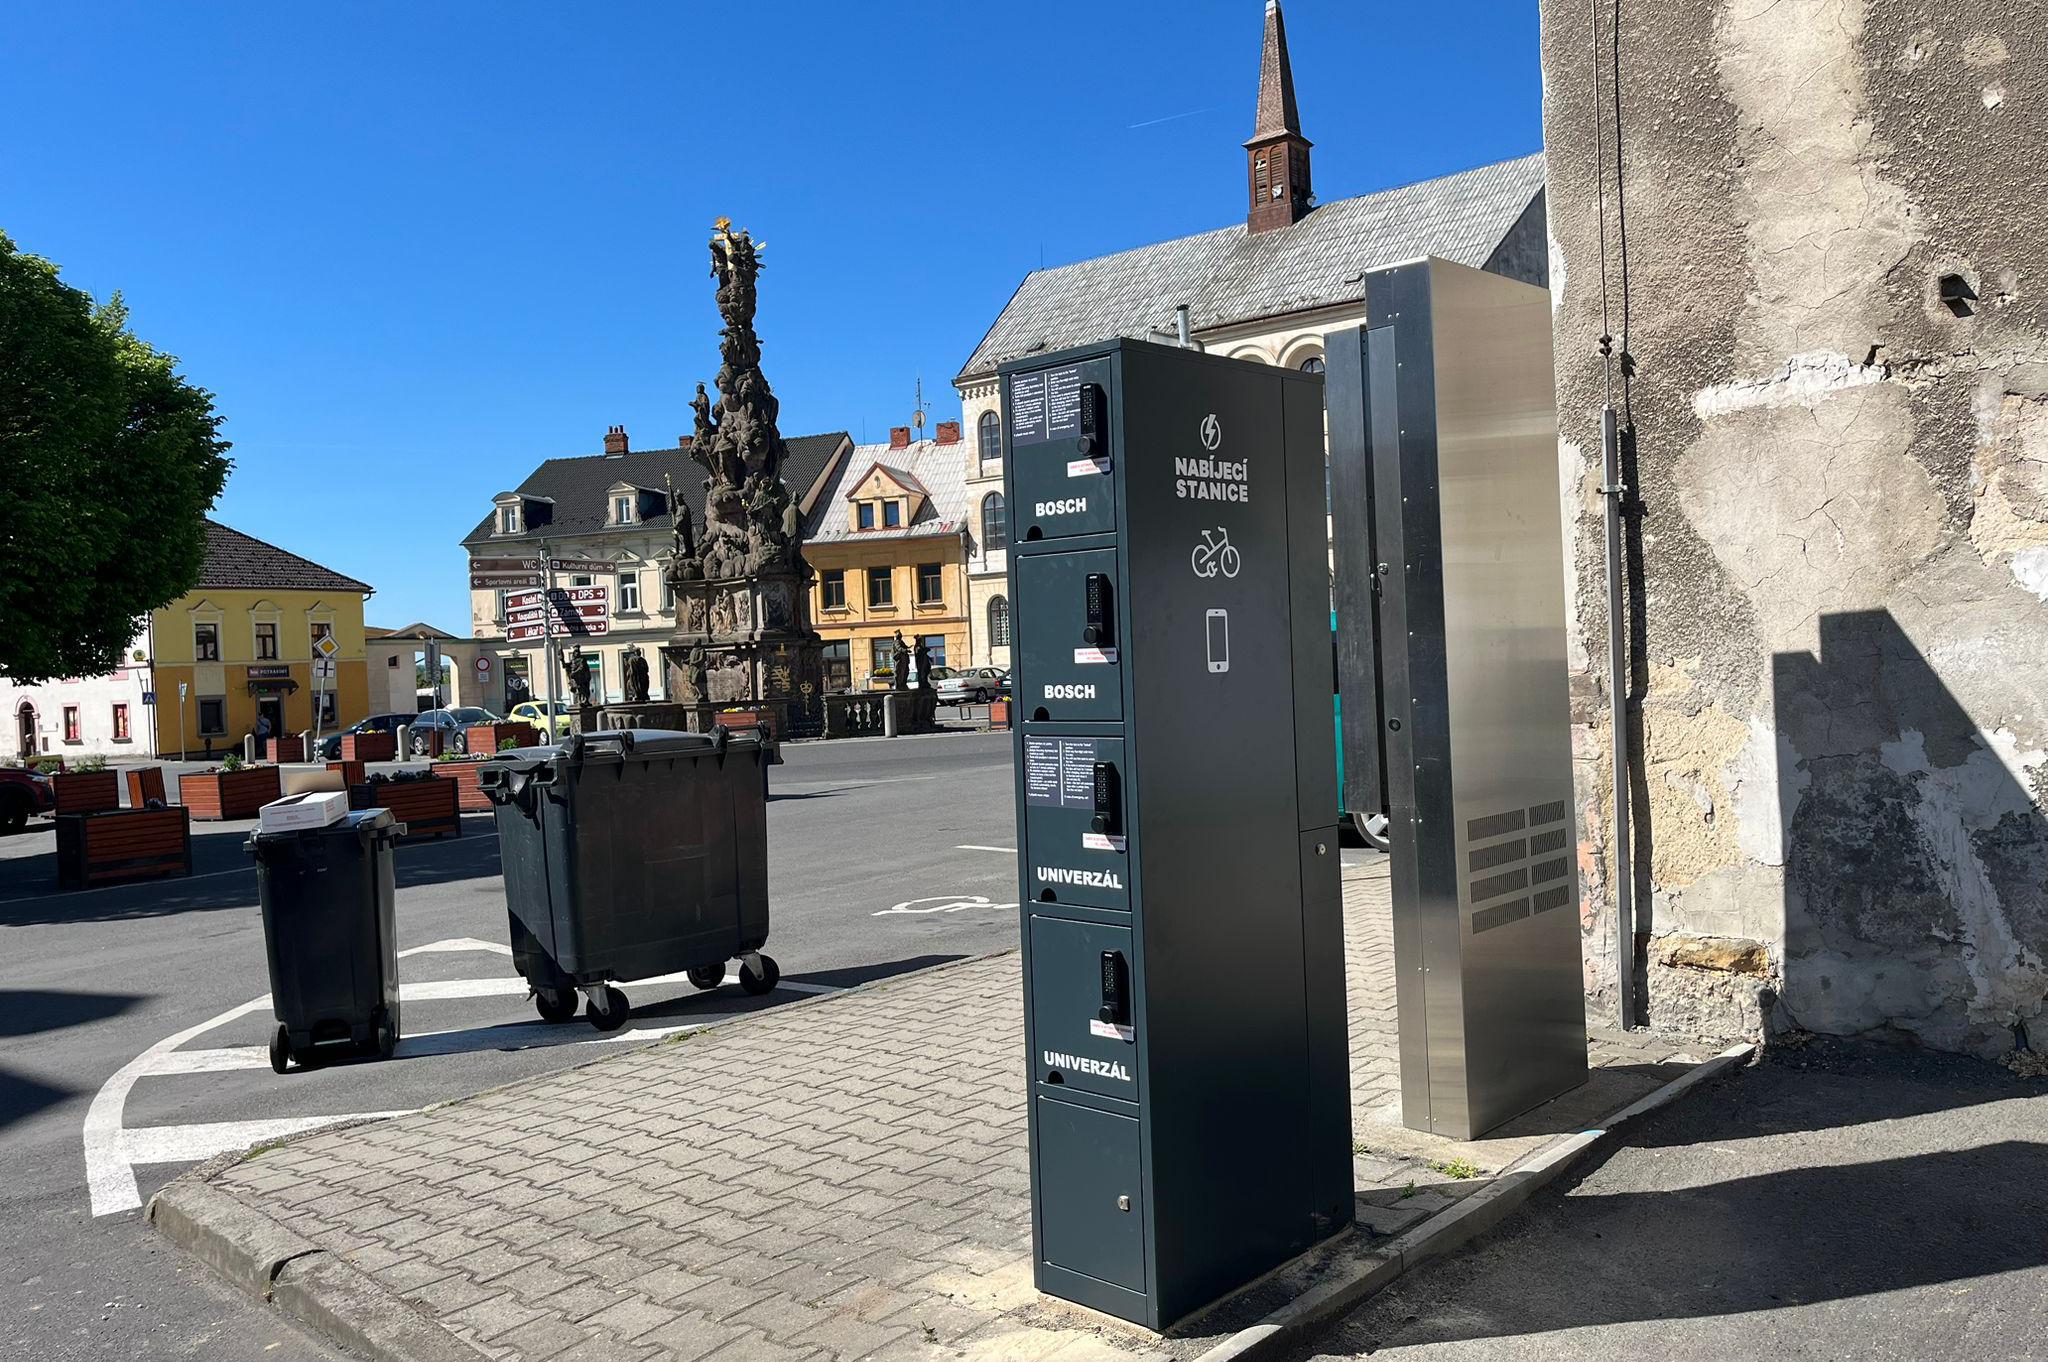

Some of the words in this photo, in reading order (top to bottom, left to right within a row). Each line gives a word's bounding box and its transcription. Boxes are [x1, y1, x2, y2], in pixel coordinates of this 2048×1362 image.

[1175, 454, 1248, 481] NABÍJECÍ
[1176, 478, 1248, 502] STANICE
[1035, 497, 1087, 517] BOSCH
[522, 560, 537, 569] WC
[578, 589, 594, 600] DPS
[1044, 684, 1096, 699] BOSCH
[1037, 866, 1123, 889] UNIVERZÁL
[1043, 1050, 1131, 1081] UNIVERZÁL
